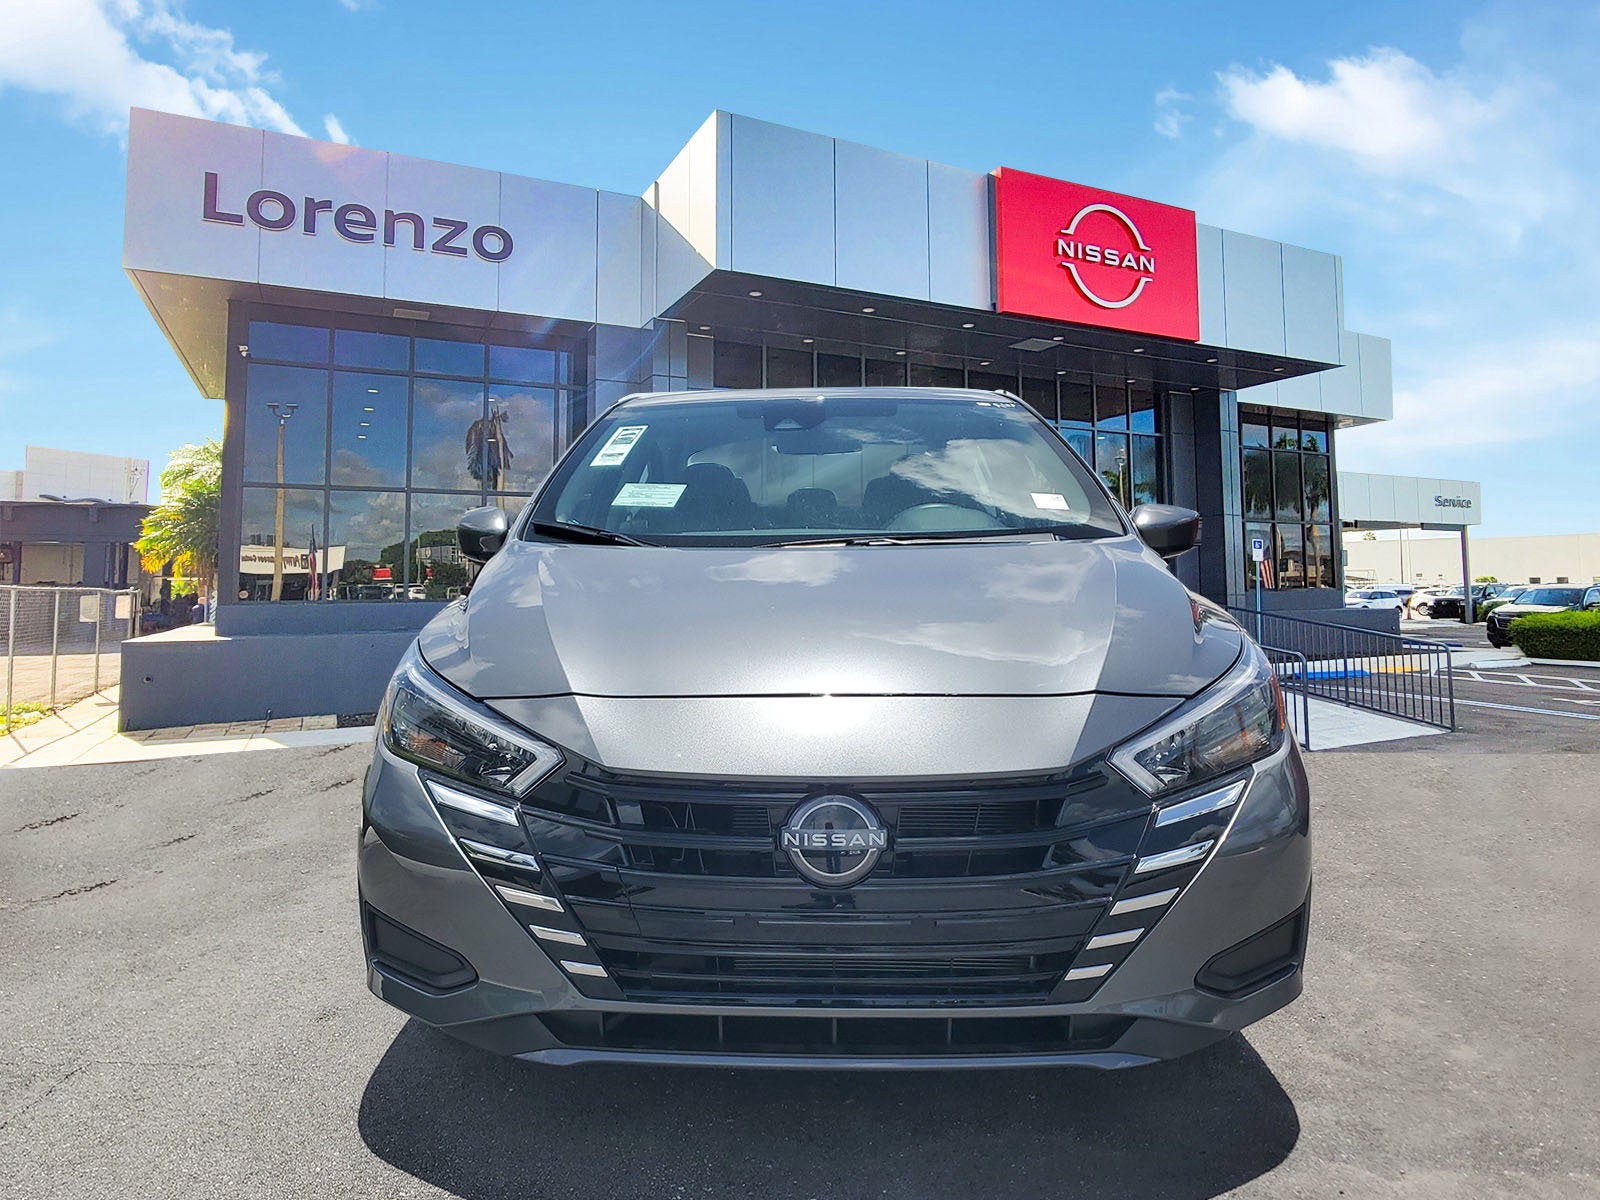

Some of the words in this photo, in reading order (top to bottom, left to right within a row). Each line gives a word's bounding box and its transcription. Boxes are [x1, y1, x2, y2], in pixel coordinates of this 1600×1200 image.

[202, 171, 514, 262] Lorenzo
[1057, 238, 1155, 273] NISSAN
[1434, 495, 1472, 508] Service
[783, 832, 884, 847] NISSAN
